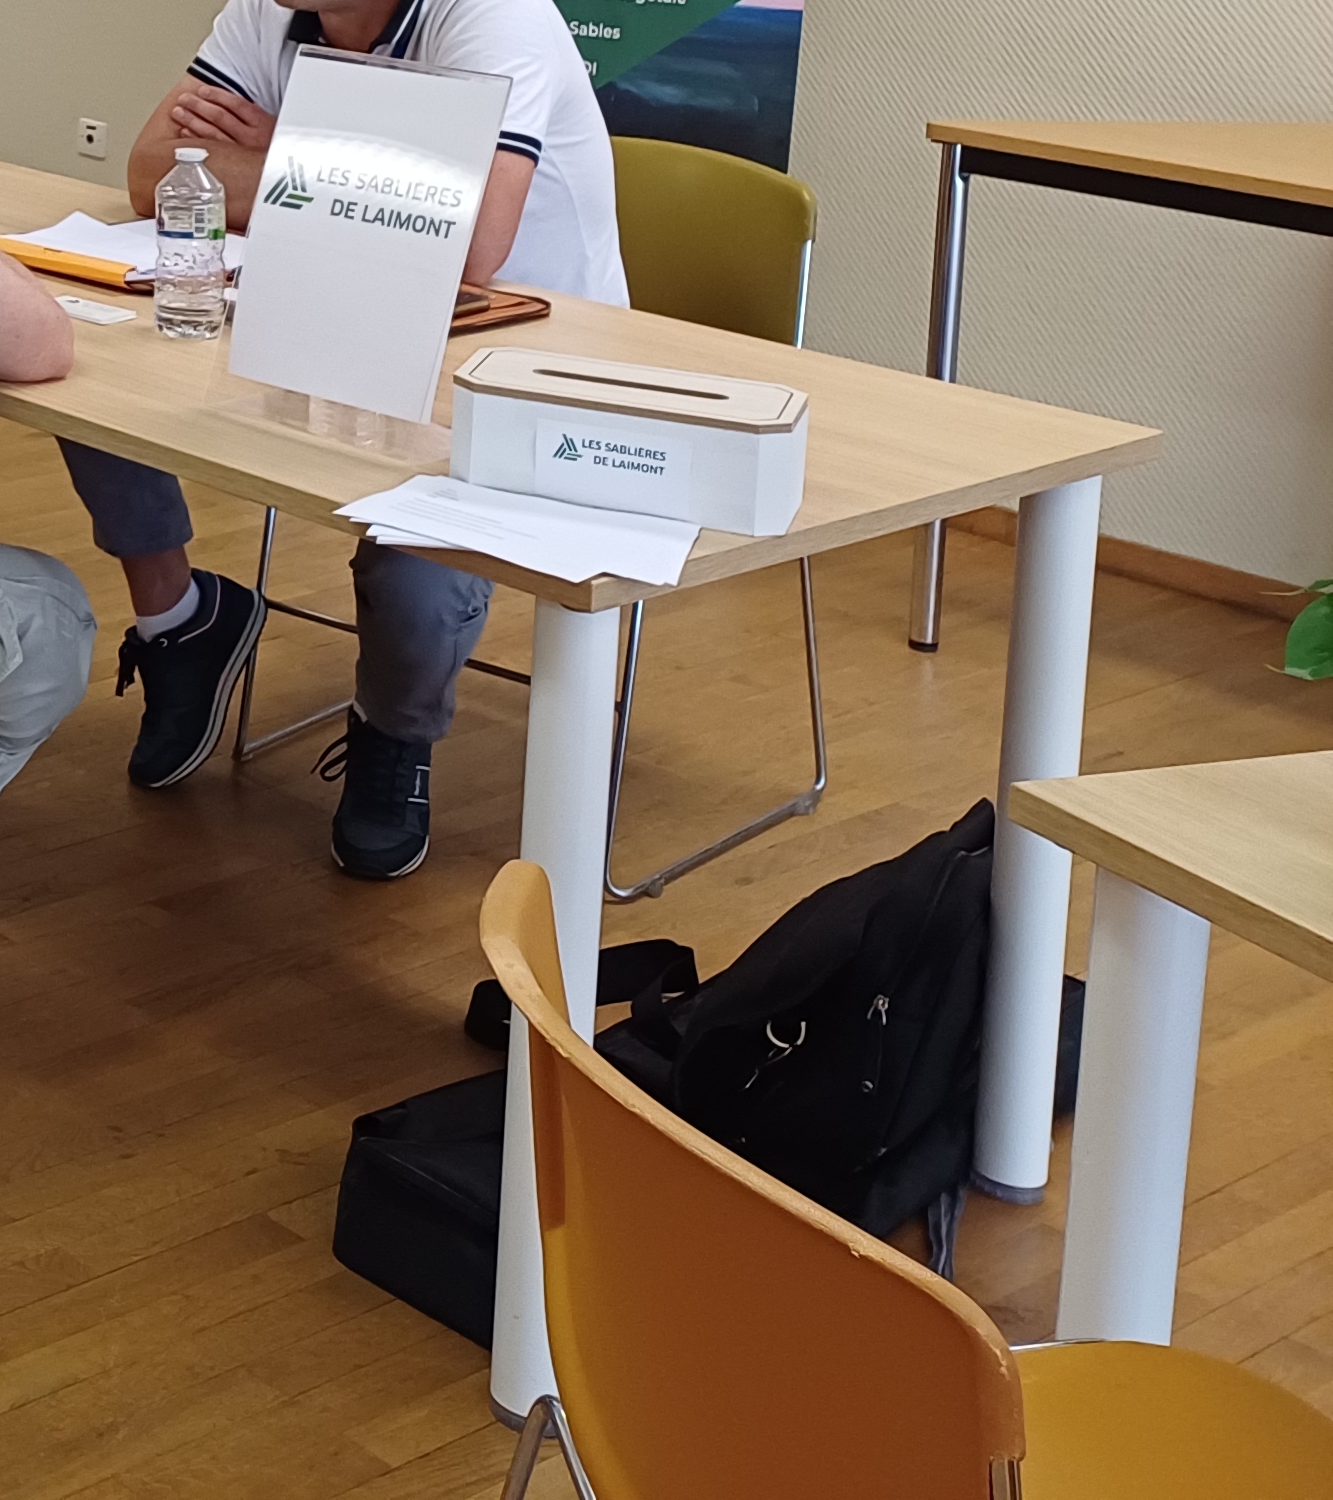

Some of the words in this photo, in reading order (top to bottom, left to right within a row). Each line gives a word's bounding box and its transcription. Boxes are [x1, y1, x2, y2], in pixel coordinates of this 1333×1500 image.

[569, 21, 621, 39] Sables
[317, 165, 350, 187] LES
[330, 199, 358, 220] DE
[361, 204, 457, 239] LAIMONT
[581, 439, 602, 450] LES
[593, 455, 609, 466] DE
[612, 458, 666, 476] LAIMONT
